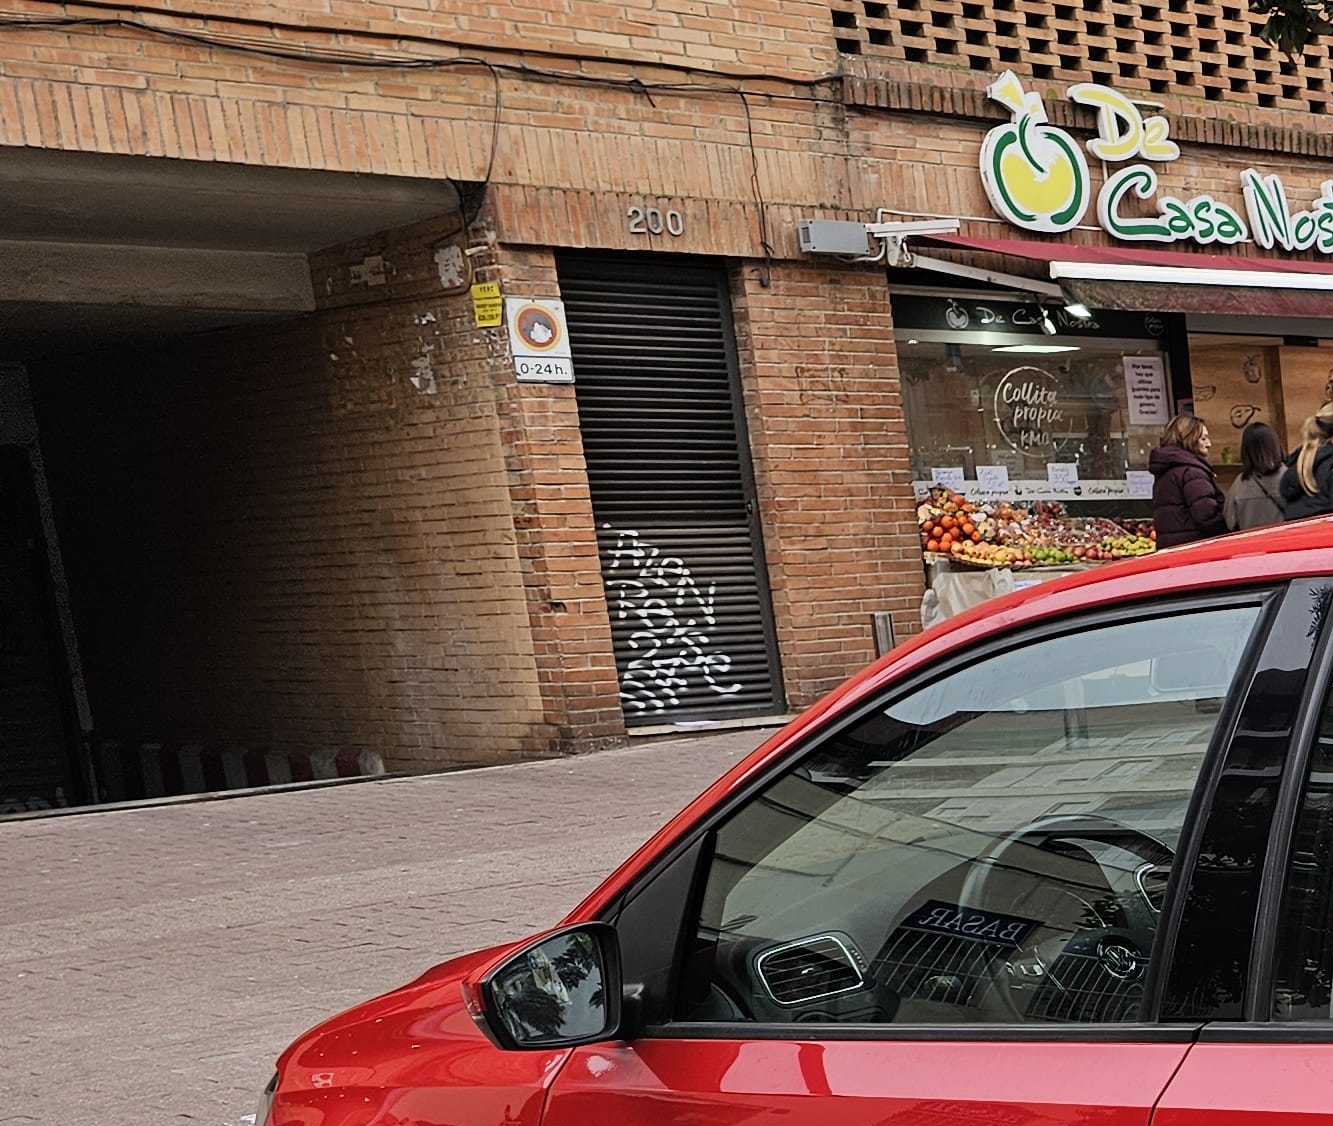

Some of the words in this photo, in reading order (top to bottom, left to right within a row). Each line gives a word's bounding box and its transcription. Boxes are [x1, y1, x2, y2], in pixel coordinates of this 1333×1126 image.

[1067, 83, 1180, 162] De
[1097, 164, 1247, 245] Casa
[627, 205, 684, 237] 200
[976, 306, 1006, 324] De
[1002, 381, 1057, 405] Collita
[1013, 405, 1064, 429] propia
